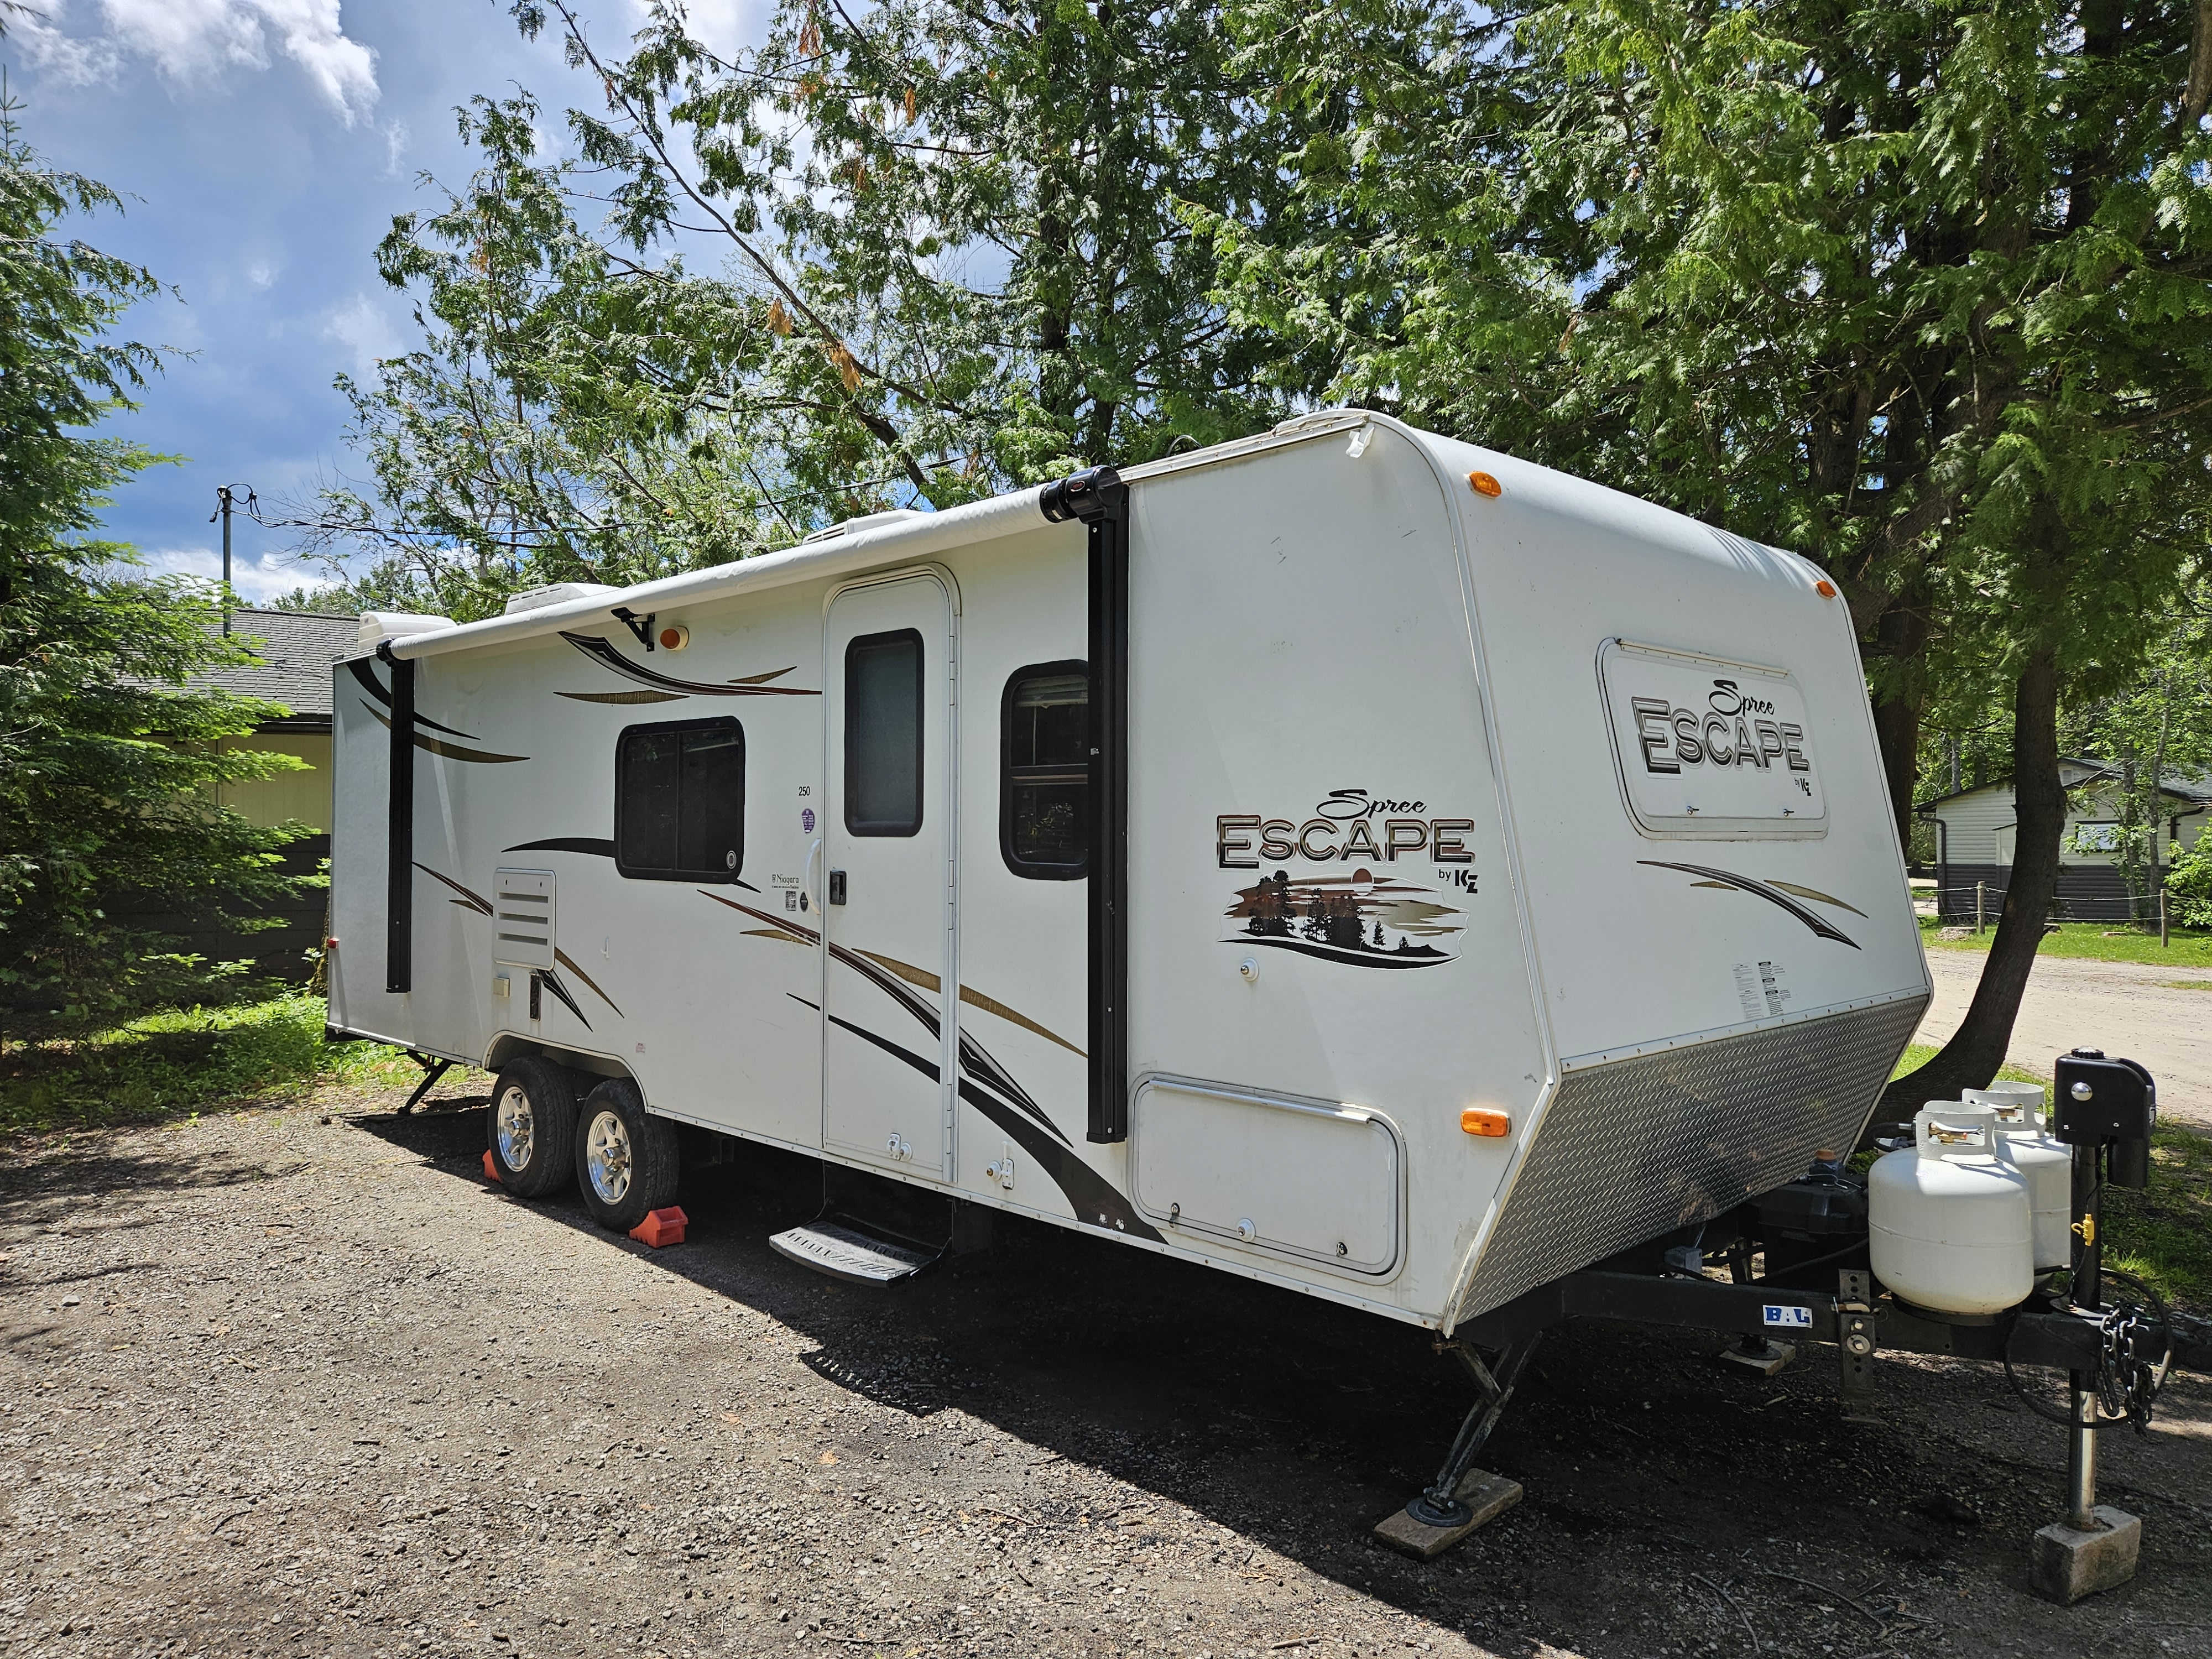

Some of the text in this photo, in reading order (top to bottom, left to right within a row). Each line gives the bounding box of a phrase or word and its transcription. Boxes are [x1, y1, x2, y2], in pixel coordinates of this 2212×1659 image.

[1708, 680, 1775, 717] Spree
[1631, 697, 1811, 775] ESCAPE
[799, 786, 811, 796] 250
[1794, 778, 1800, 788] by
[1316, 789, 1427, 821] Spree
[1217, 815, 1475, 869] ESCAPE
[777, 873, 800, 886] Niagara
[1438, 869, 1478, 894] by KZ
[1765, 1307, 1811, 1324] BAL
